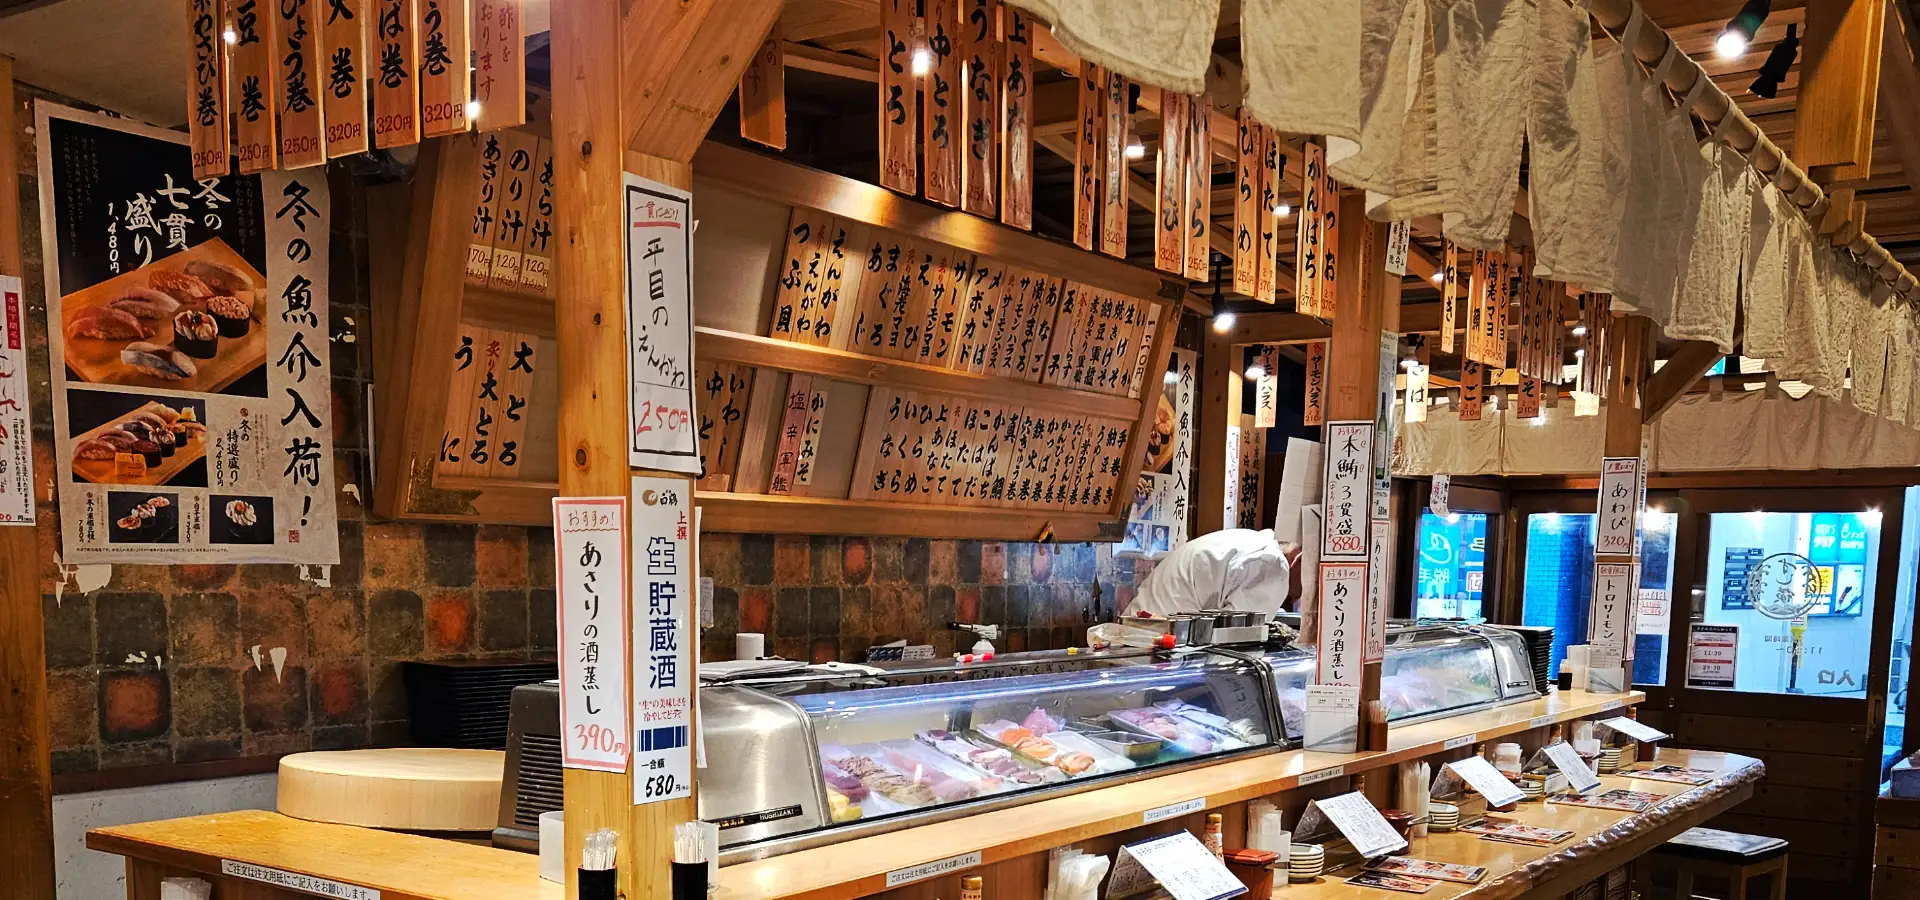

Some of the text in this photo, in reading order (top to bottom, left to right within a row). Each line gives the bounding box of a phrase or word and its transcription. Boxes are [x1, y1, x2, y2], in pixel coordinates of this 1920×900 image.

[479, 3, 496, 103] おります
[887, 0, 906, 125] とろ
[238, 144, 270, 162] 250円
[283, 137, 319, 157] 250円
[328, 122, 361, 143] 320円
[376, 114, 412, 135] 320円
[424, 103, 463, 123] 320円
[194, 150, 223, 168] 250円
[472, 134, 502, 240] あさり汁
[500, 148, 530, 245] のり汁
[530, 156, 553, 252] あら汁
[1238, 123, 1253, 253] ひらめ
[1263, 138, 1277, 259] ほたて
[125, 192, 163, 271] 盛り
[155, 173, 195, 252] 七貫
[466, 247, 490, 269] 170円
[495, 252, 519, 275] 120円
[525, 257, 549, 278] 120円
[776, 223, 810, 334] つぶ貝
[814, 228, 846, 339] えんがわ
[854, 241, 883, 345] あじ
[870, 244, 901, 347] まぐろ
[904, 254, 932, 350] えび
[936, 259, 967, 358] サーモン
[959, 267, 989, 364] アボカド
[1002, 276, 1031, 368] サーモンハラス
[1016, 278, 1045, 373] 漬けまぐろ
[1031, 282, 1058, 373] あなご
[1108, 303, 1135, 389] 生げそ
[1120, 309, 1146, 387] いか
[439, 334, 473, 464] うに
[636, 399, 689, 437] 250円
[718, 372, 745, 467] いわし
[1261, 345, 1276, 411] サーモンハラス
[239, 418, 252, 442] 冬の
[772, 389, 806, 493] 塩辛軍艦
[796, 392, 824, 482] かにみそ
[873, 396, 901, 492] うなぎ
[890, 400, 917, 494] いくら
[904, 404, 933, 495] ひらめ
[921, 404, 948, 493] 上あなご
[952, 408, 978, 496] ほたて
[963, 409, 991, 498] こはだ
[1017, 417, 1045, 501] 鉄火巻
[1603, 535, 1630, 549] 320円
[1610, 482, 1629, 531] あわび
[579, 540, 602, 716] あさりの酒蒸し
[646, 535, 678, 691] 生貯蔵酒
[1329, 581, 1348, 681] あさりの酒蒸し
[1602, 579, 1617, 640] トロサーモン
[573, 723, 626, 757] 390円
[641, 758, 665, 770] 一合瓶
[645, 773, 681, 799] 580円
